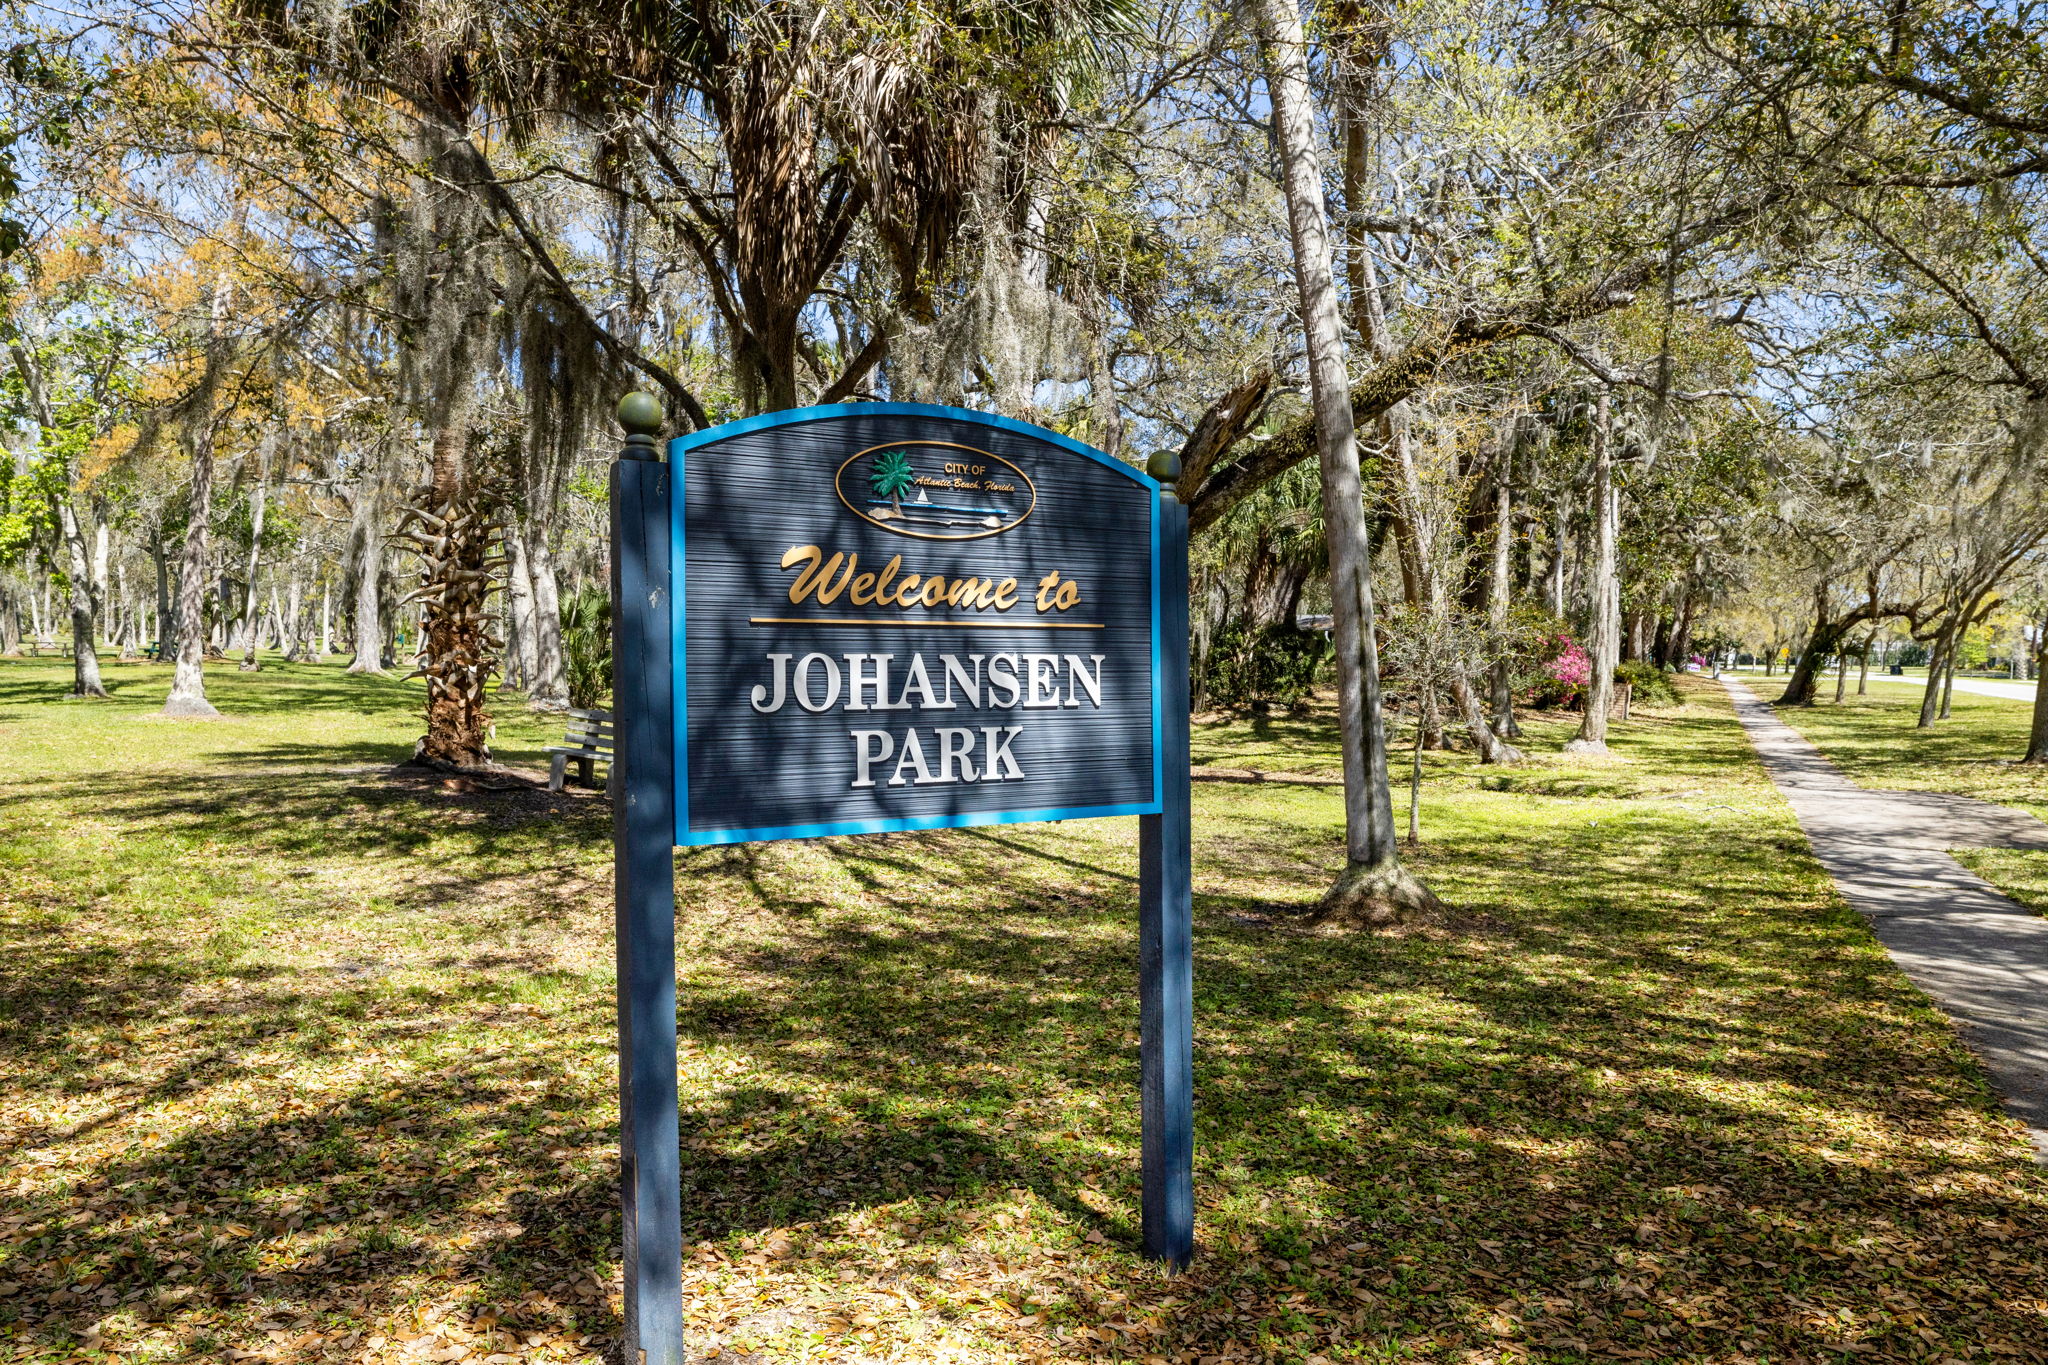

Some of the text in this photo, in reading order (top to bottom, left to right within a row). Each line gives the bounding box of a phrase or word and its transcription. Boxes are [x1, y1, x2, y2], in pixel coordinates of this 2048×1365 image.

[914, 476, 951, 487] Atlantic
[984, 480, 1016, 492] Florida
[944, 463, 986, 476] CITY OF
[781, 545, 1081, 613] Welcome to
[751, 652, 1105, 713] JOHANSEN
[850, 725, 1025, 787] PARK
